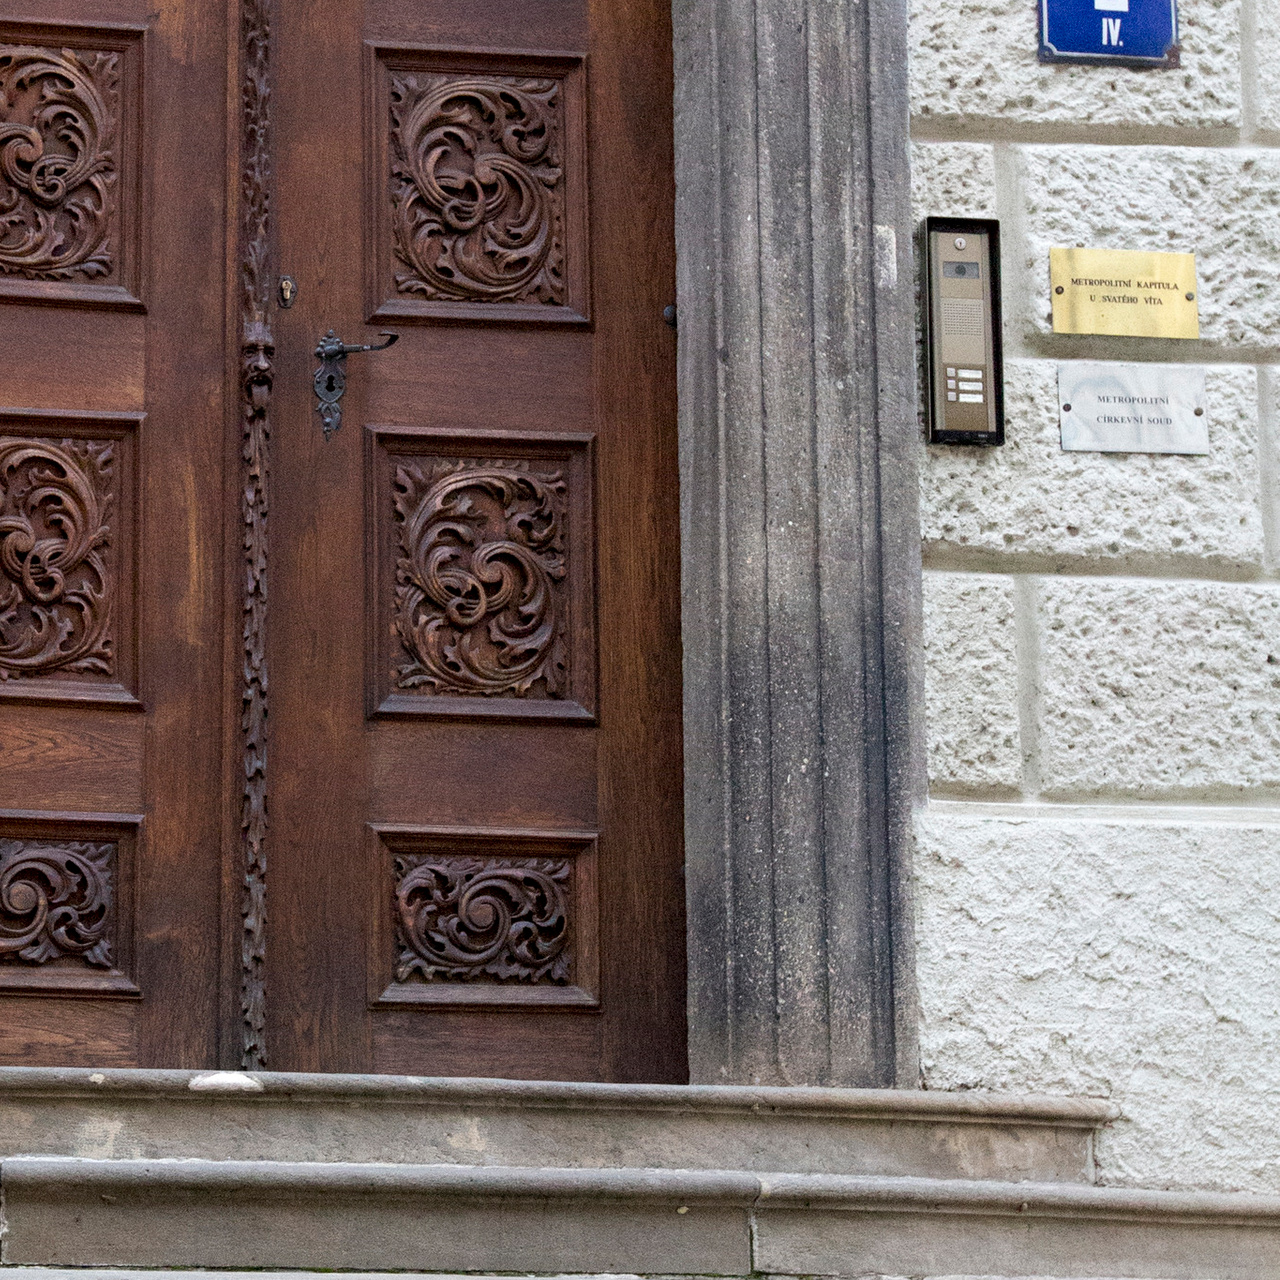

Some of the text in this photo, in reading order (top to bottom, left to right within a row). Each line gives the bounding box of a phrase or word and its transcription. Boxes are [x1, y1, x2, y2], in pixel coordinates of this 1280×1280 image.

[1101, 17, 1124, 47] IV.
[1071, 278, 1179, 291] METROPOLITNÍ KAPITULA
[1089, 293, 1163, 305] U SVATÉHO VÍTA
[1097, 395, 1169, 405] METROPOLITNÍ
[1096, 414, 1173, 425] CÍRKEVNÍ SOUD
